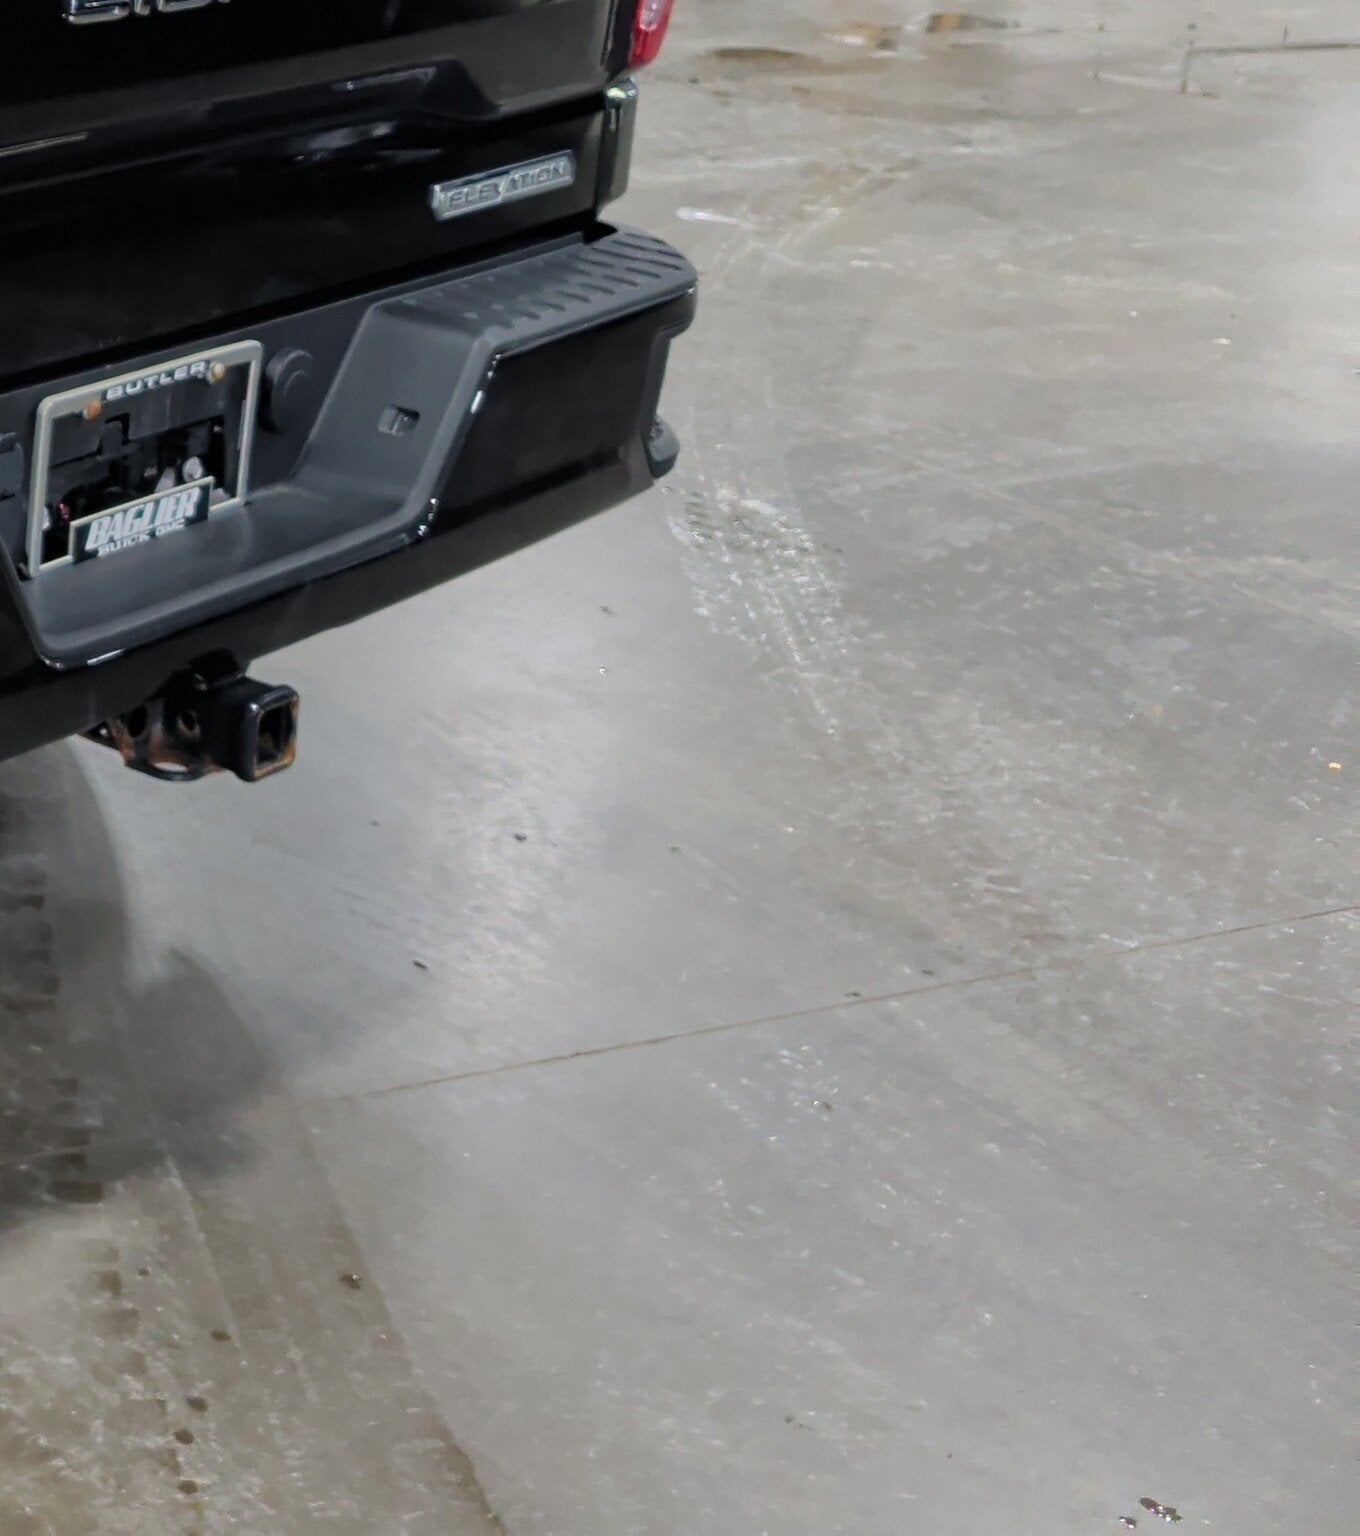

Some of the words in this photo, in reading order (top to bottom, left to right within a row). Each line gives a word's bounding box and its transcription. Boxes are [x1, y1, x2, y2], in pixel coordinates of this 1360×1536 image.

[105, 361, 207, 401] BUTLER
[84, 487, 201, 551] BAGLIER
[98, 532, 151, 556] BUICK
